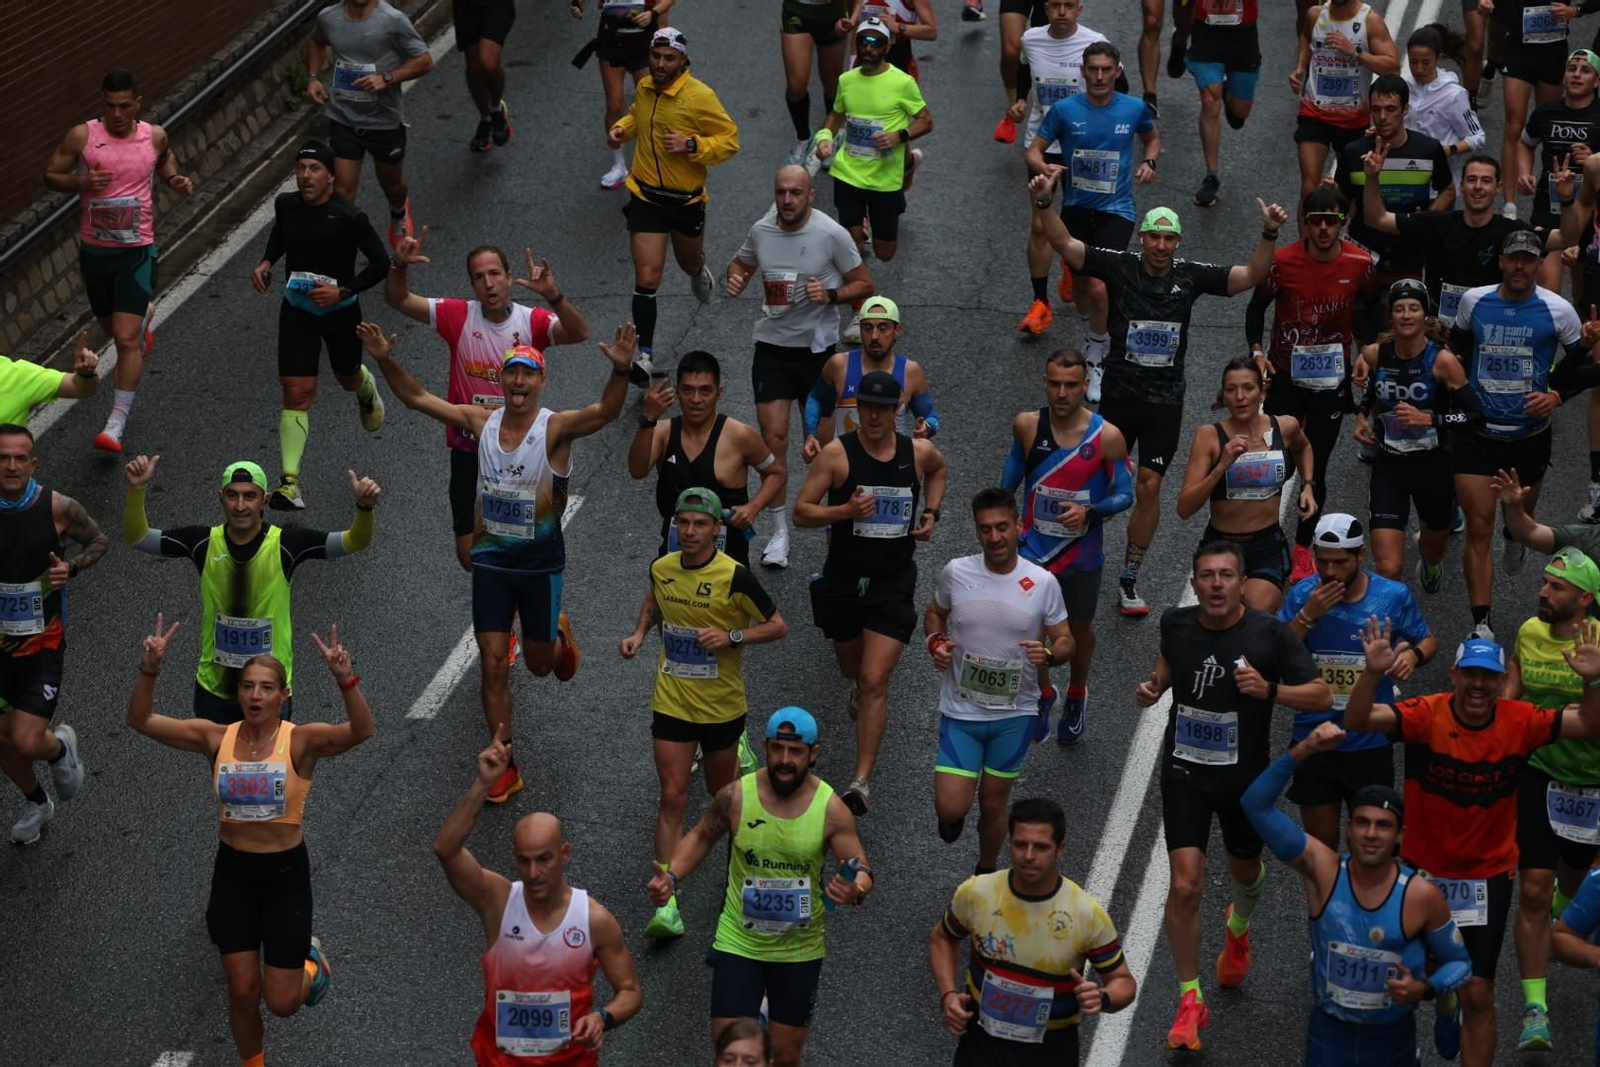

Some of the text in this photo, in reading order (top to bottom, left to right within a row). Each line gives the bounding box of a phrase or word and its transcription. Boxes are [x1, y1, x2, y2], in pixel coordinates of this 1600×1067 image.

[1550, 123, 1589, 141] PONS
[1134, 331, 1168, 348] 3399
[1502, 325, 1533, 339] santa
[1299, 356, 1332, 371] 2632
[1486, 357, 1519, 373] 2515
[1375, 380, 1429, 402] 3FDC
[1236, 463, 1271, 481] 2347
[489, 500, 521, 518] 1736
[695, 581, 713, 597] LS
[222, 629, 259, 647] 1915
[669, 637, 702, 657] 3275
[969, 666, 1007, 688] 7063
[1184, 721, 1223, 743] 1898
[227, 777, 270, 797] 3302
[1554, 797, 1597, 819] 3367
[762, 859, 811, 874] Running
[752, 893, 795, 912] 3235
[1336, 959, 1380, 983] 3111
[989, 989, 1034, 1018] 2277
[507, 1007, 554, 1029] 2099
